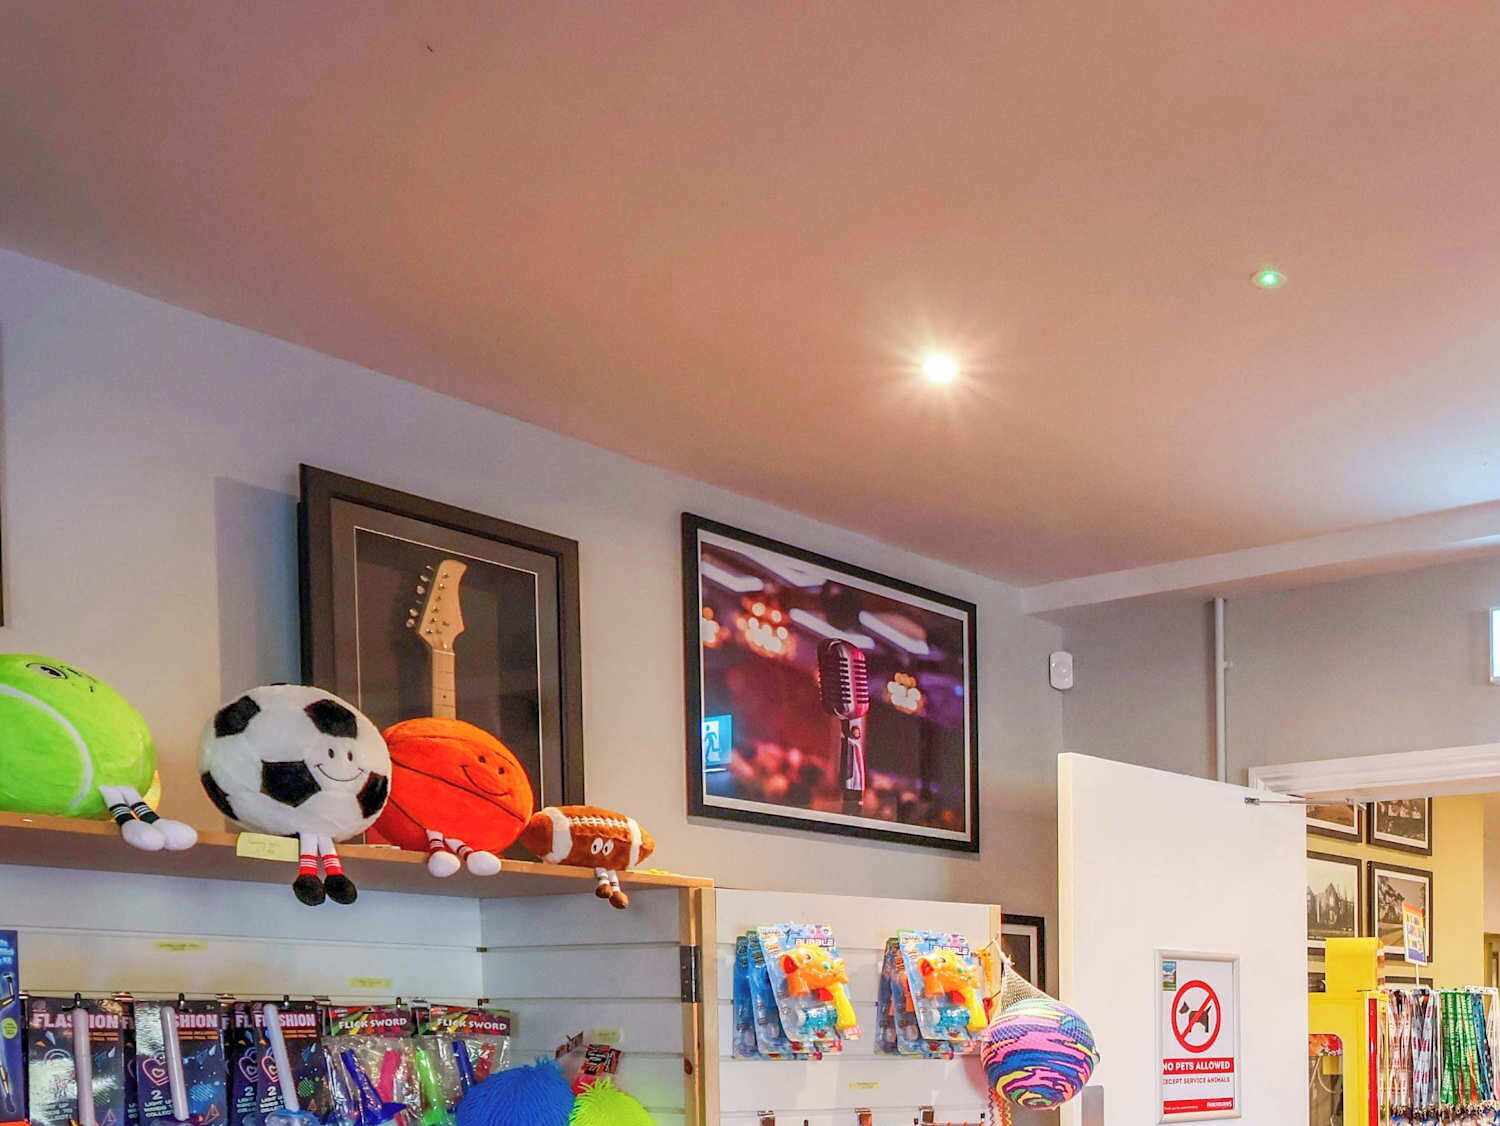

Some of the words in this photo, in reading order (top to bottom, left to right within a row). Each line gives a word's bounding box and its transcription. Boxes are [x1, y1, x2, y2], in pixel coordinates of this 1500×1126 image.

[338, 1020, 368, 1029] FLICK
[370, 1017, 407, 1027] SWORD
[437, 1018, 467, 1028] FLICK
[469, 1021, 507, 1031] SWORD
[1163, 1062, 1174, 1071] NO
[1175, 1062, 1194, 1070] PETS
[1195, 1060, 1230, 1070] ALLOWED
